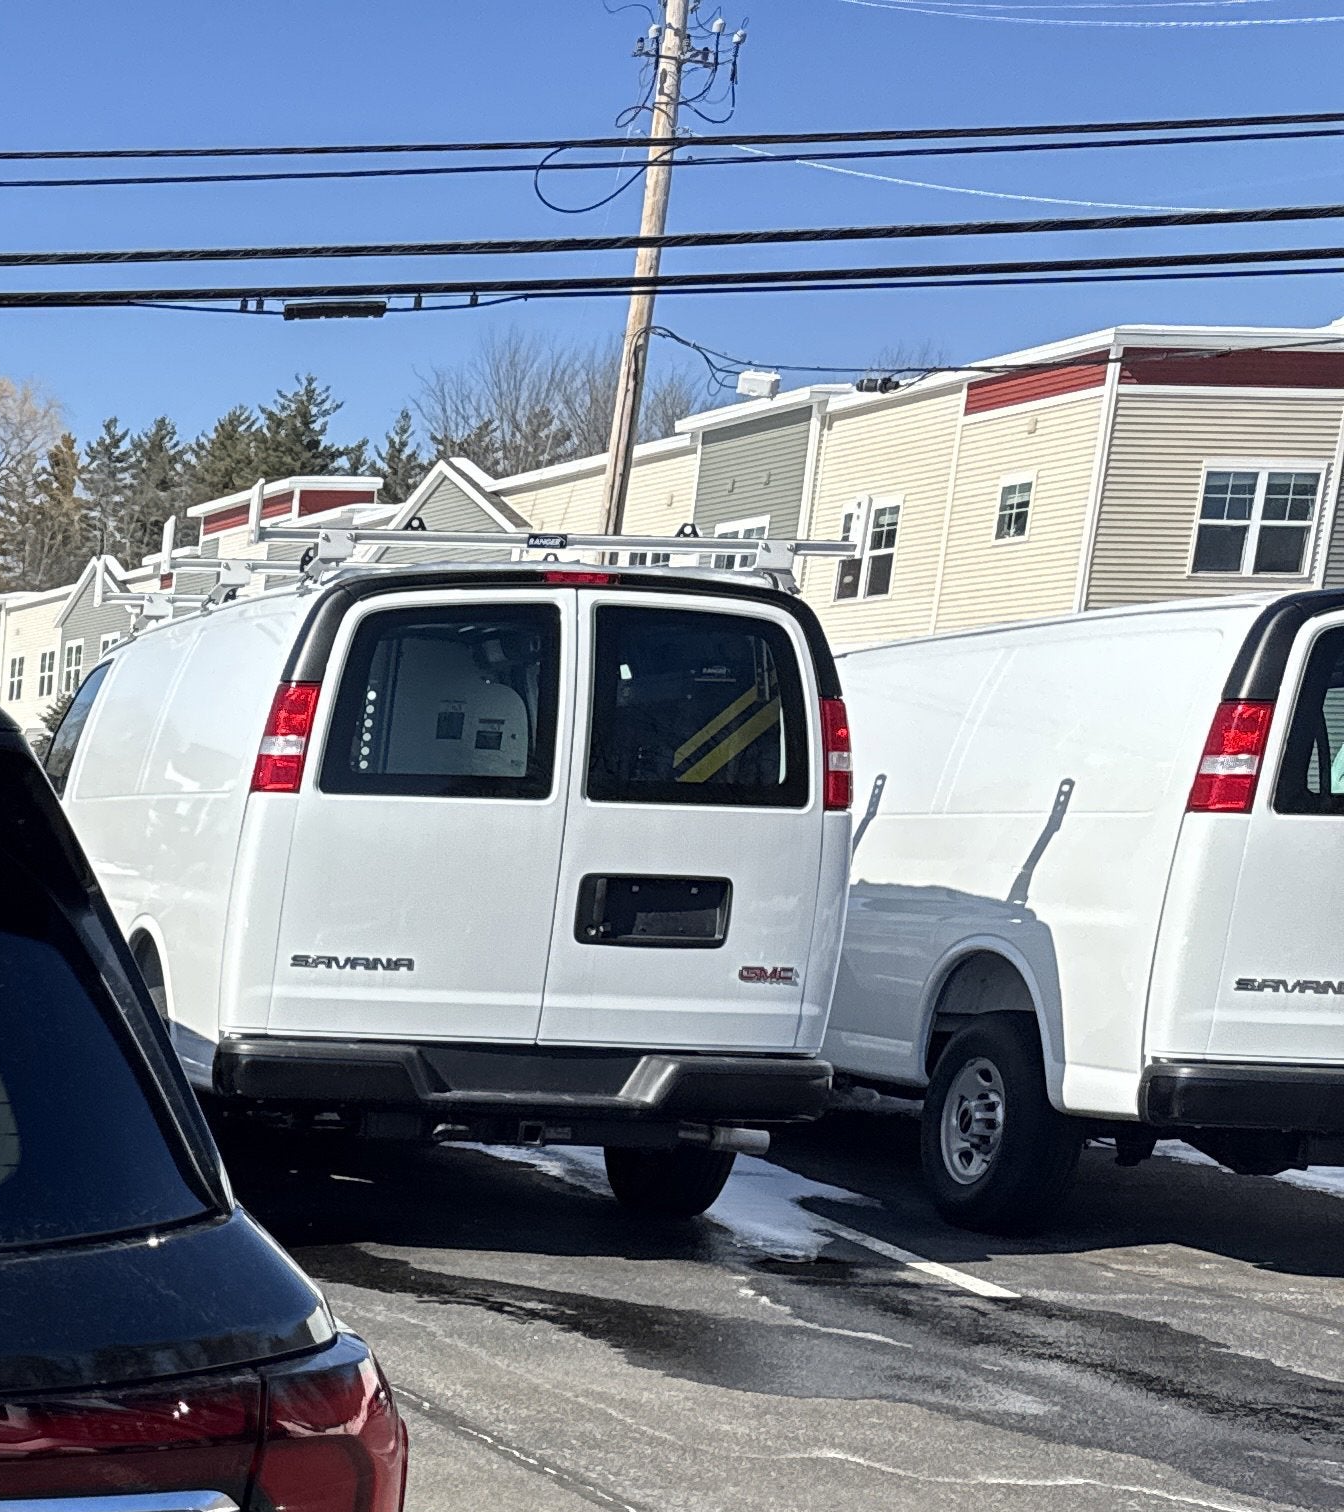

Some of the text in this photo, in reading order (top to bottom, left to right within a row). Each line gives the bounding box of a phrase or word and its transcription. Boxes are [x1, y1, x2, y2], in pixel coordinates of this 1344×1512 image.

[529, 538, 561, 546] RANGER
[290, 954, 415, 972] SAVANA
[738, 966, 795, 981] GMC
